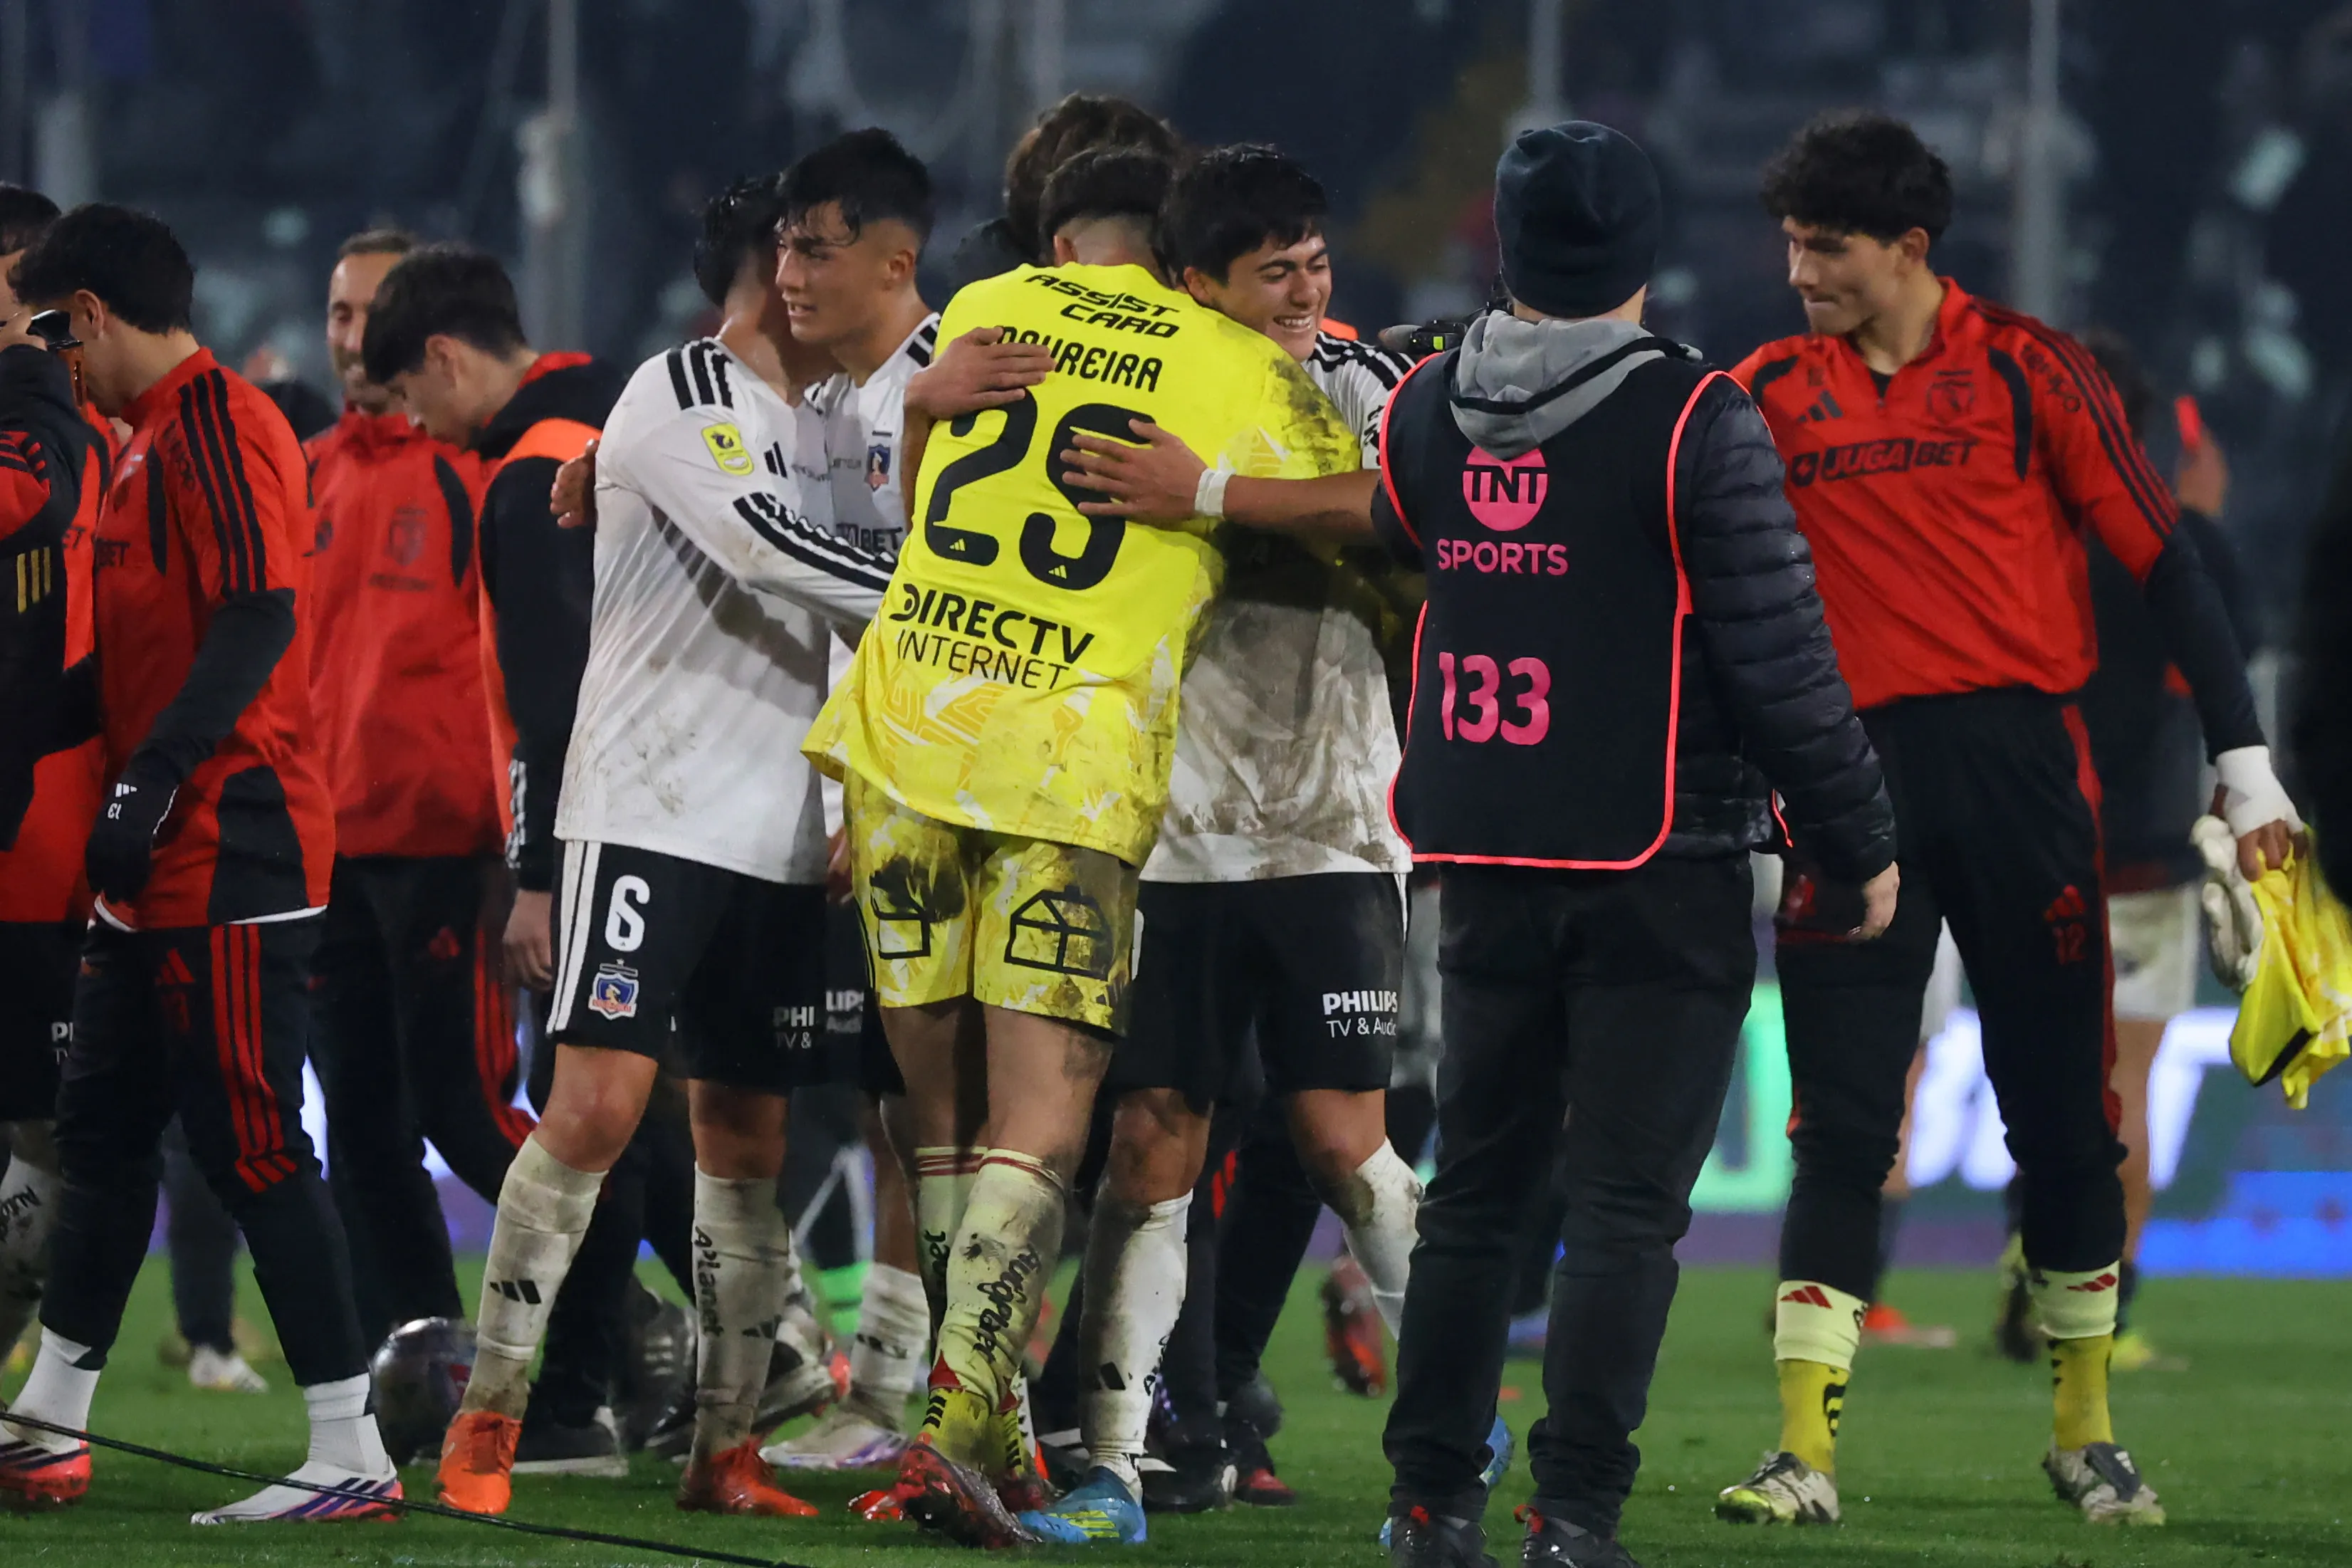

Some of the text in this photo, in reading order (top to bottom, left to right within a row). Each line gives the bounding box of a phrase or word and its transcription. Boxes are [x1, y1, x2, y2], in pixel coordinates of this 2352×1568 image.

[1023, 274, 1181, 318] ASSIST
[1060, 303, 1180, 339] CARD
[925, 387, 1156, 591] 29
[1463, 464, 1549, 504] TNT
[1437, 538, 1569, 576] SPORTS
[889, 582, 1095, 664] DIRECTV
[897, 628, 1070, 690] INTERNET
[1438, 651, 1552, 746] 133
[605, 874, 650, 952] 6
[1322, 990, 1398, 1015] PHILIPS
[800, 1031, 811, 1049] &
[1326, 1018, 1352, 1038] TV
[1357, 1017, 1370, 1035] &
